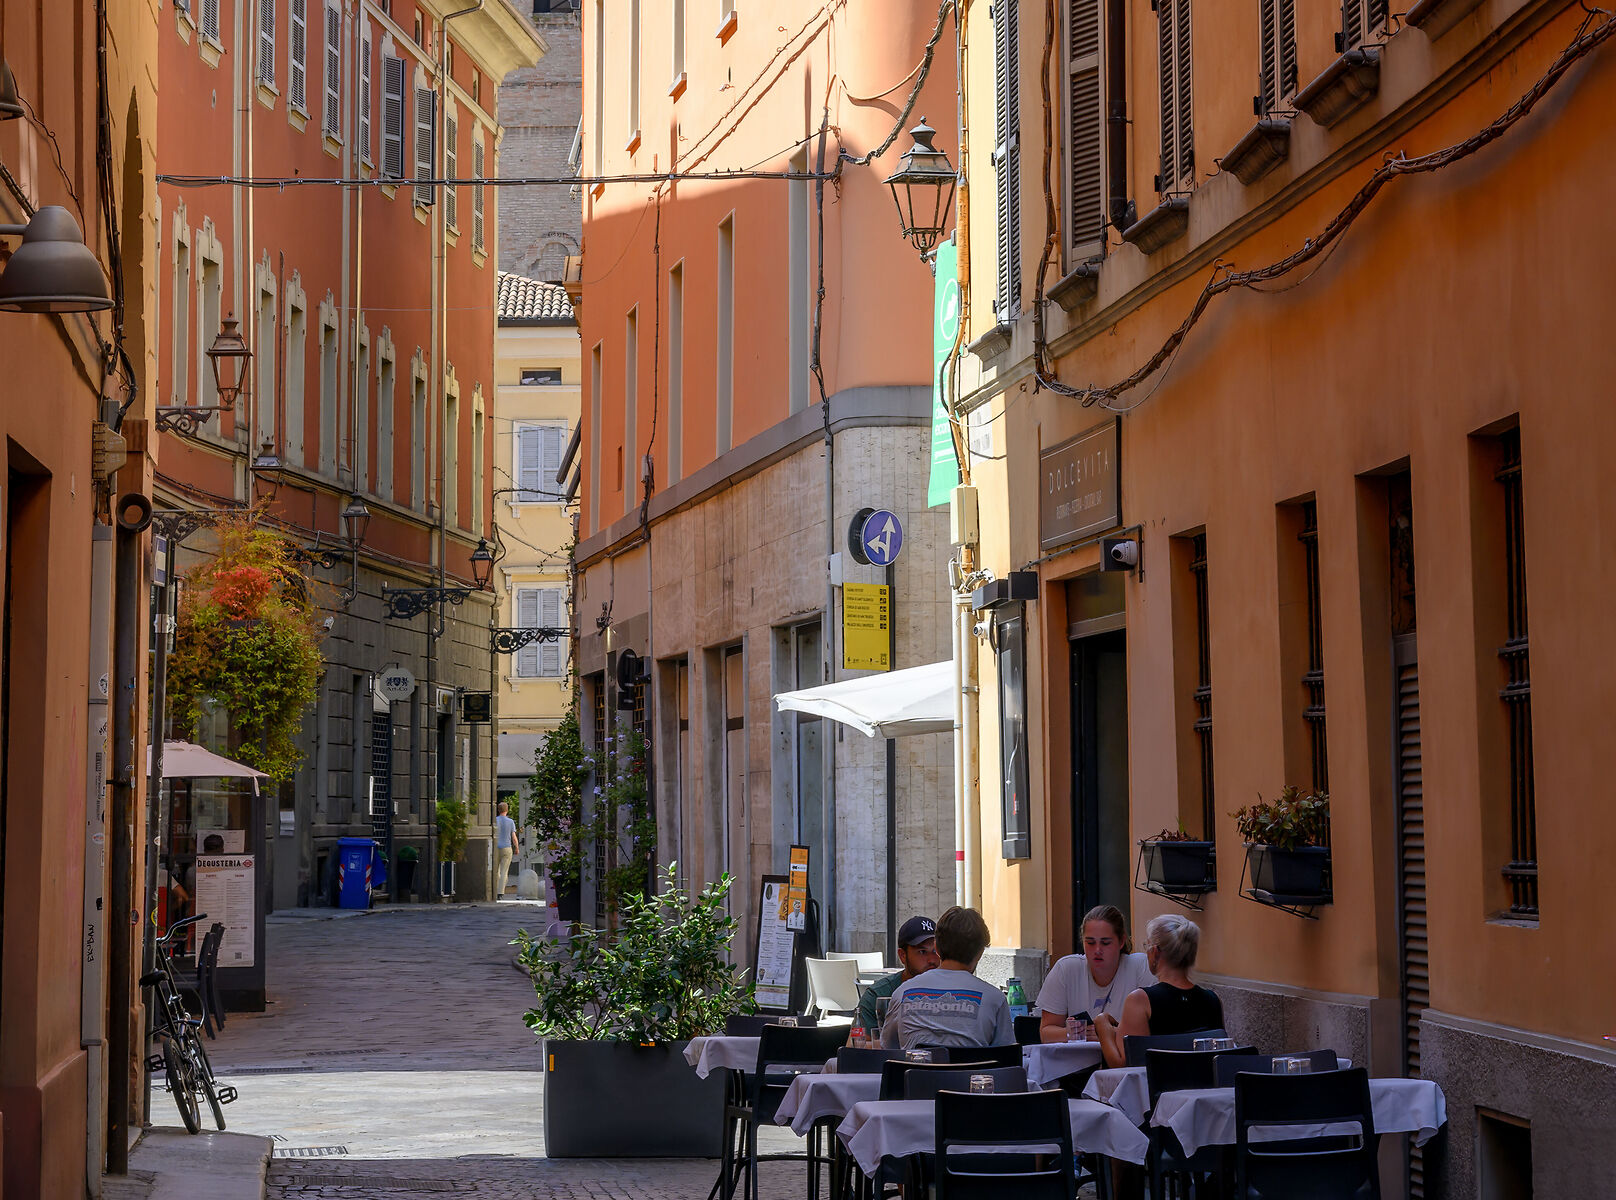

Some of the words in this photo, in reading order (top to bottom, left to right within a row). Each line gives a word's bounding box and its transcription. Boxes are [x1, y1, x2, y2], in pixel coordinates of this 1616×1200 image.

[1049, 447, 1109, 495] DOLCEVITA
[197, 859, 242, 868] DEGUSTERIA
[921, 920, 934, 931] NY
[902, 1000, 975, 1014] patagonia
